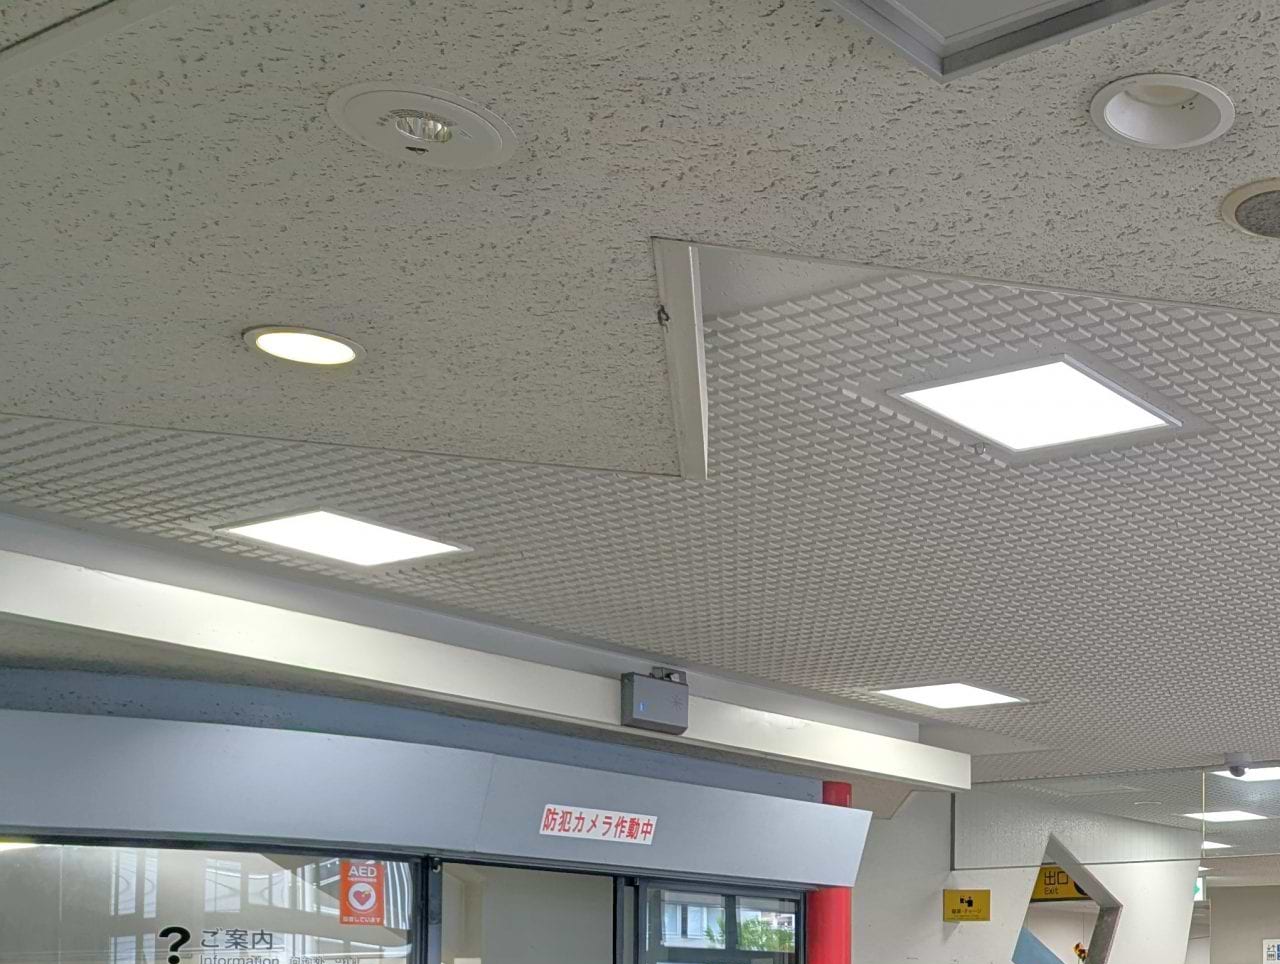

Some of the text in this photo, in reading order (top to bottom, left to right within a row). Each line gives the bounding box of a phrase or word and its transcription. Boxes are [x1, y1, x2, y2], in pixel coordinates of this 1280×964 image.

[543, 809, 654, 841] 防犯カメラ作動中
[348, 866, 377, 877] AED
[1044, 871, 1068, 885] 出口
[201, 928, 273, 950] ご案内
